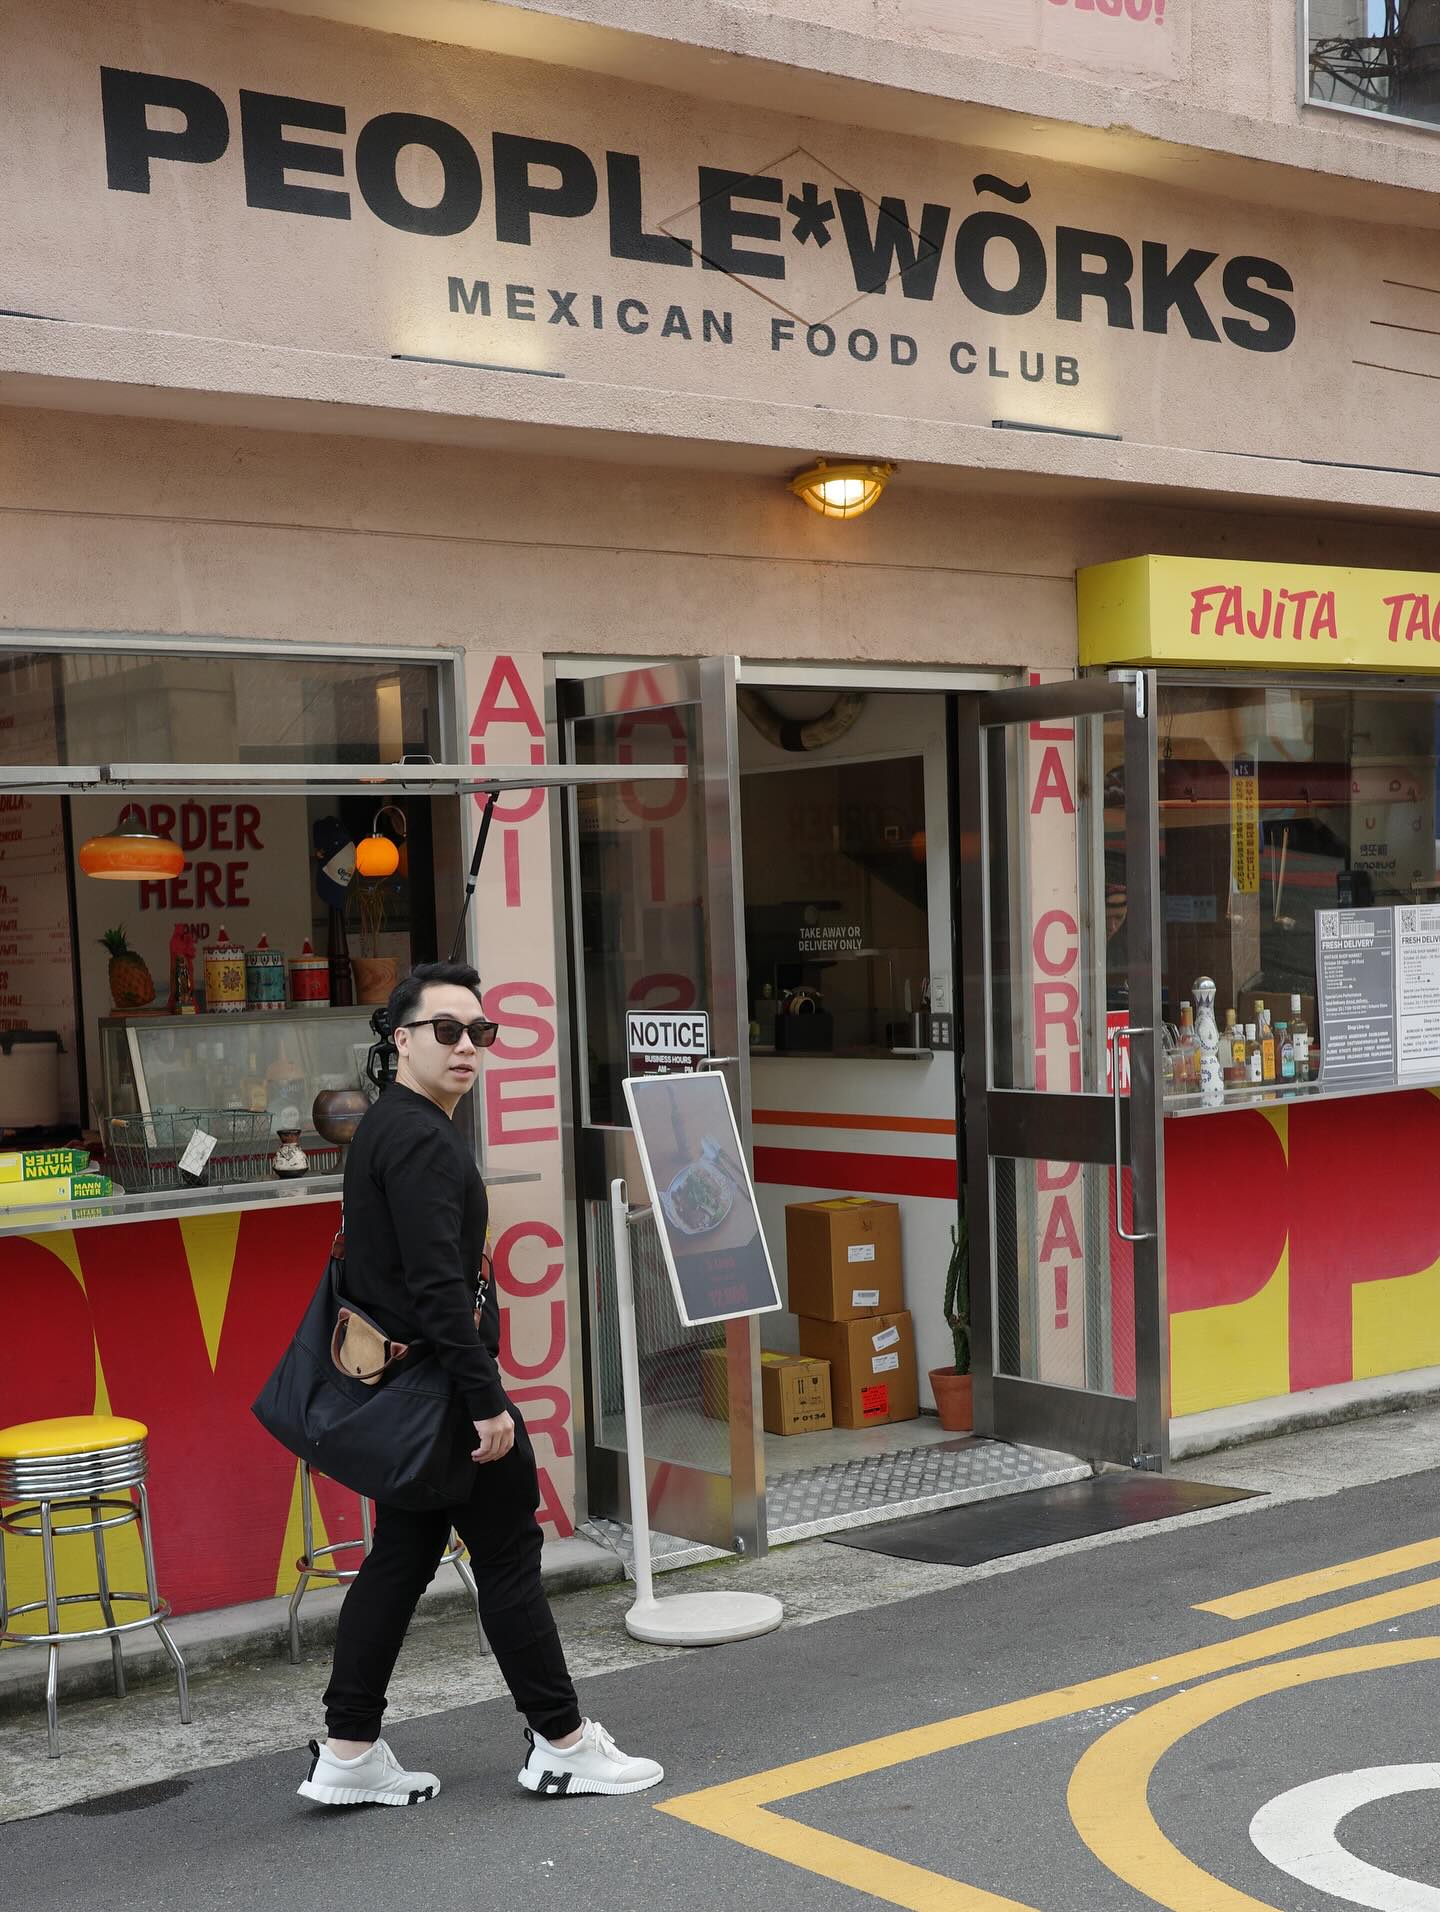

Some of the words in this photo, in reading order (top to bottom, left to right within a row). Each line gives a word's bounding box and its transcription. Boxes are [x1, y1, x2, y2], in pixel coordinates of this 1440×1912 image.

[448, 276, 733, 345] MEXICAN
[771, 319, 919, 366] FOOD
[949, 341, 1080, 387] CLUB
[1029, 673, 1076, 814] LA
[140, 861, 250, 910] HERE
[800, 927, 821, 938] TAKE
[823, 926, 846, 938] AWAY
[847, 926, 861, 937] OR
[798, 940, 839, 951] DELIVERY
[840, 939, 862, 950] ONLY
[1322, 941, 1343, 951] FRESH
[1343, 939, 1374, 949] DELIVERY
[1401, 936, 1421, 944] FRESH
[630, 1022, 705, 1047] NOTICE
[481, 981, 560, 1147] SE
[644, 1055, 671, 1063] BUSINESS
[672, 1056, 692, 1064] HOURS
[25, 1152, 72, 1166] FILTER
[26, 1162, 73, 1177] MANN
[74, 1182, 101, 1190] MANN
[74, 1189, 101, 1197] FILTER
[802, 1412, 826, 1422] 0134
